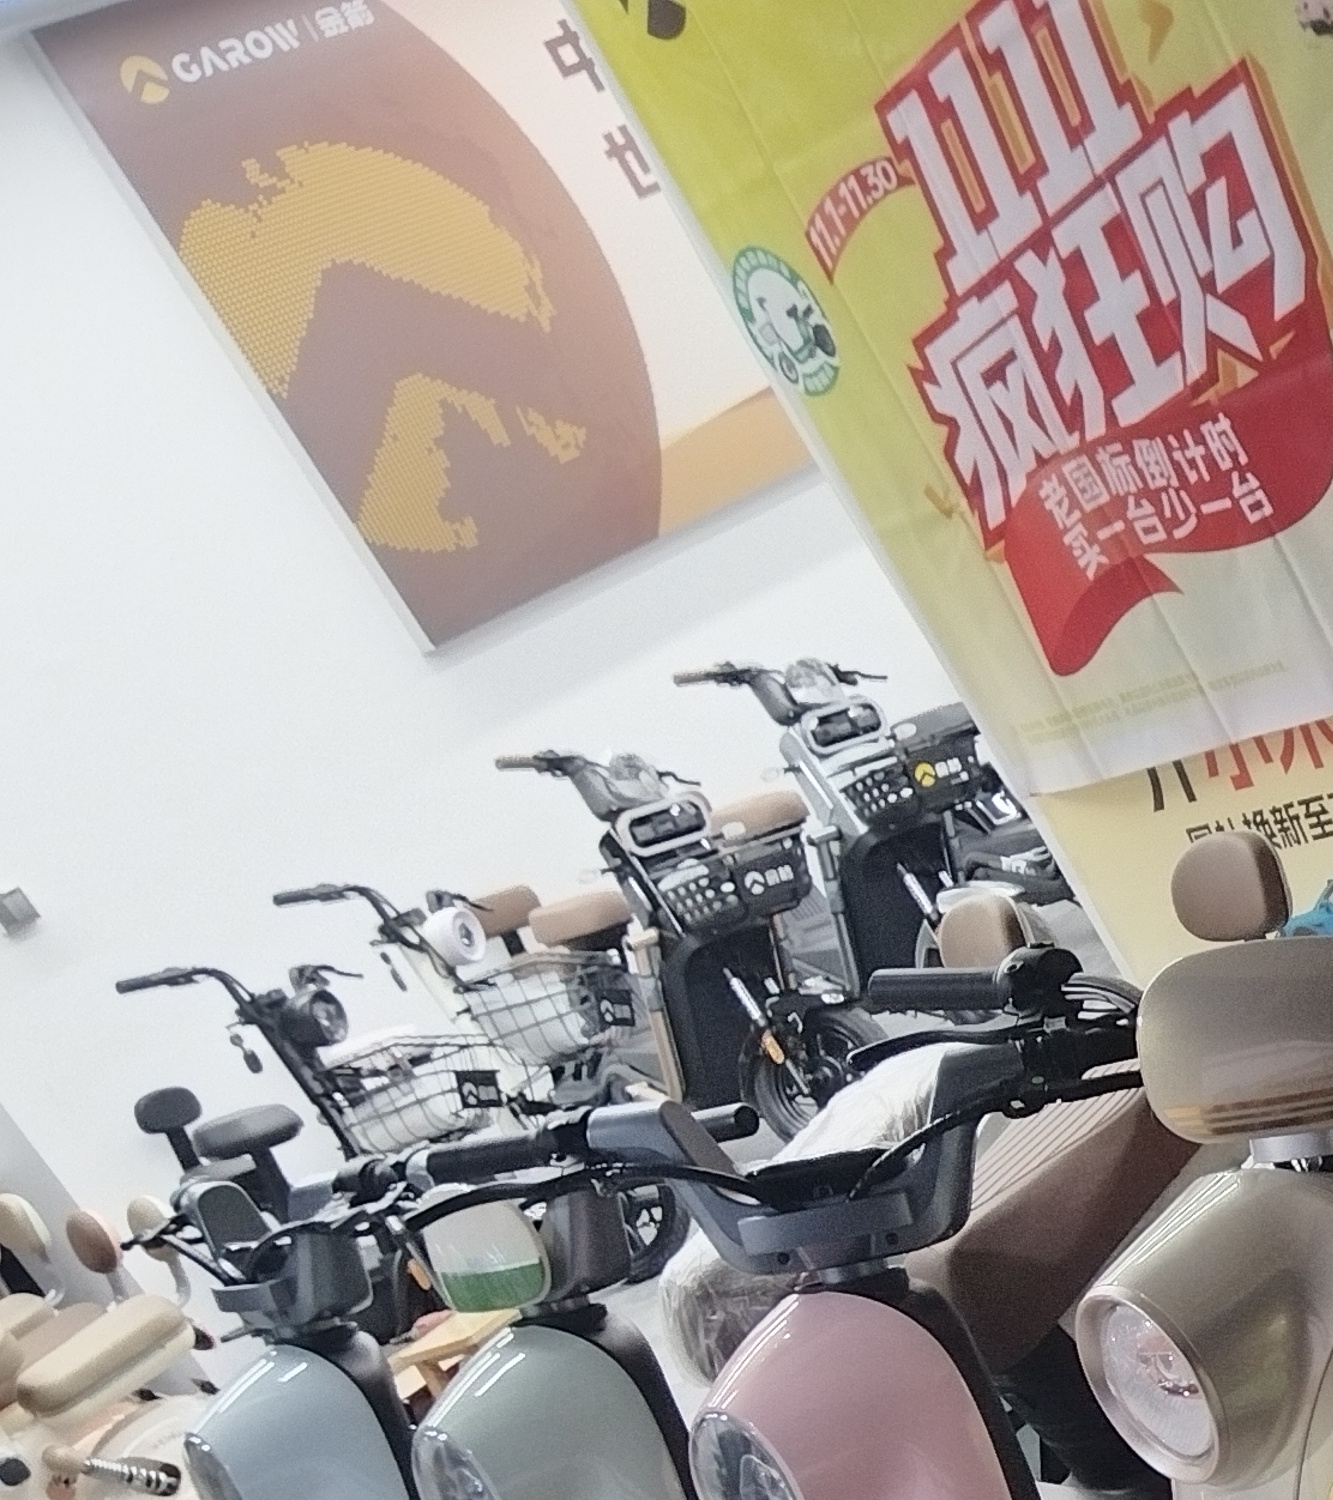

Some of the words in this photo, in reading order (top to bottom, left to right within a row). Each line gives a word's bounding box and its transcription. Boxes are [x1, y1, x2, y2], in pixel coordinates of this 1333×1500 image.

[172, 19, 300, 82] GAROW
[544, 19, 605, 92] 中
[602, 124, 661, 200] 世
[810, 159, 898, 270] 11.1-11.30
[923, 82, 1305, 531] 疯狂购
[1039, 412, 1248, 530] 老国标倒计时
[1063, 471, 1273, 580] 买一台少一台
